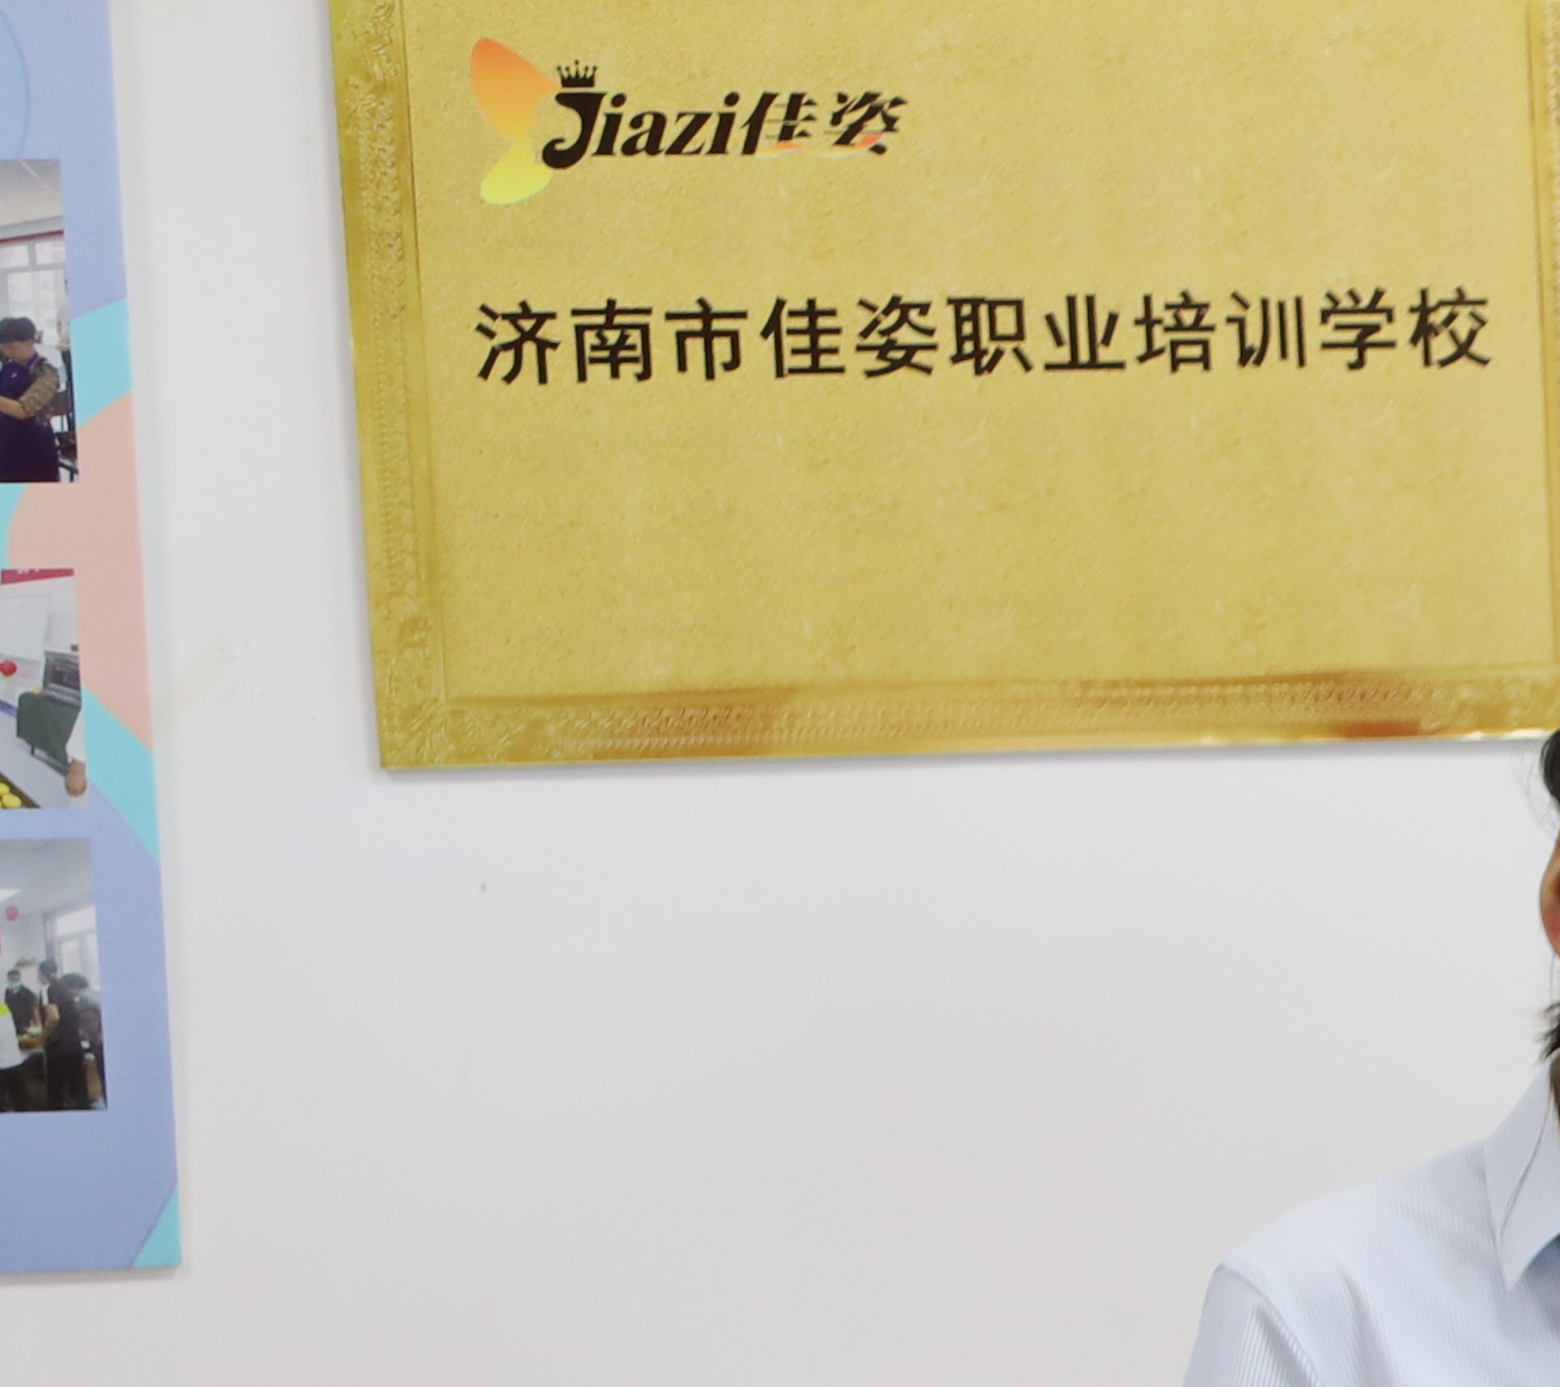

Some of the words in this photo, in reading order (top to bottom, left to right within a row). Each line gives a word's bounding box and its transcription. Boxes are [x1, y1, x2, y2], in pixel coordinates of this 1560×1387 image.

[474, 287, 1492, 385] 济南市佳姿职业培训学校
